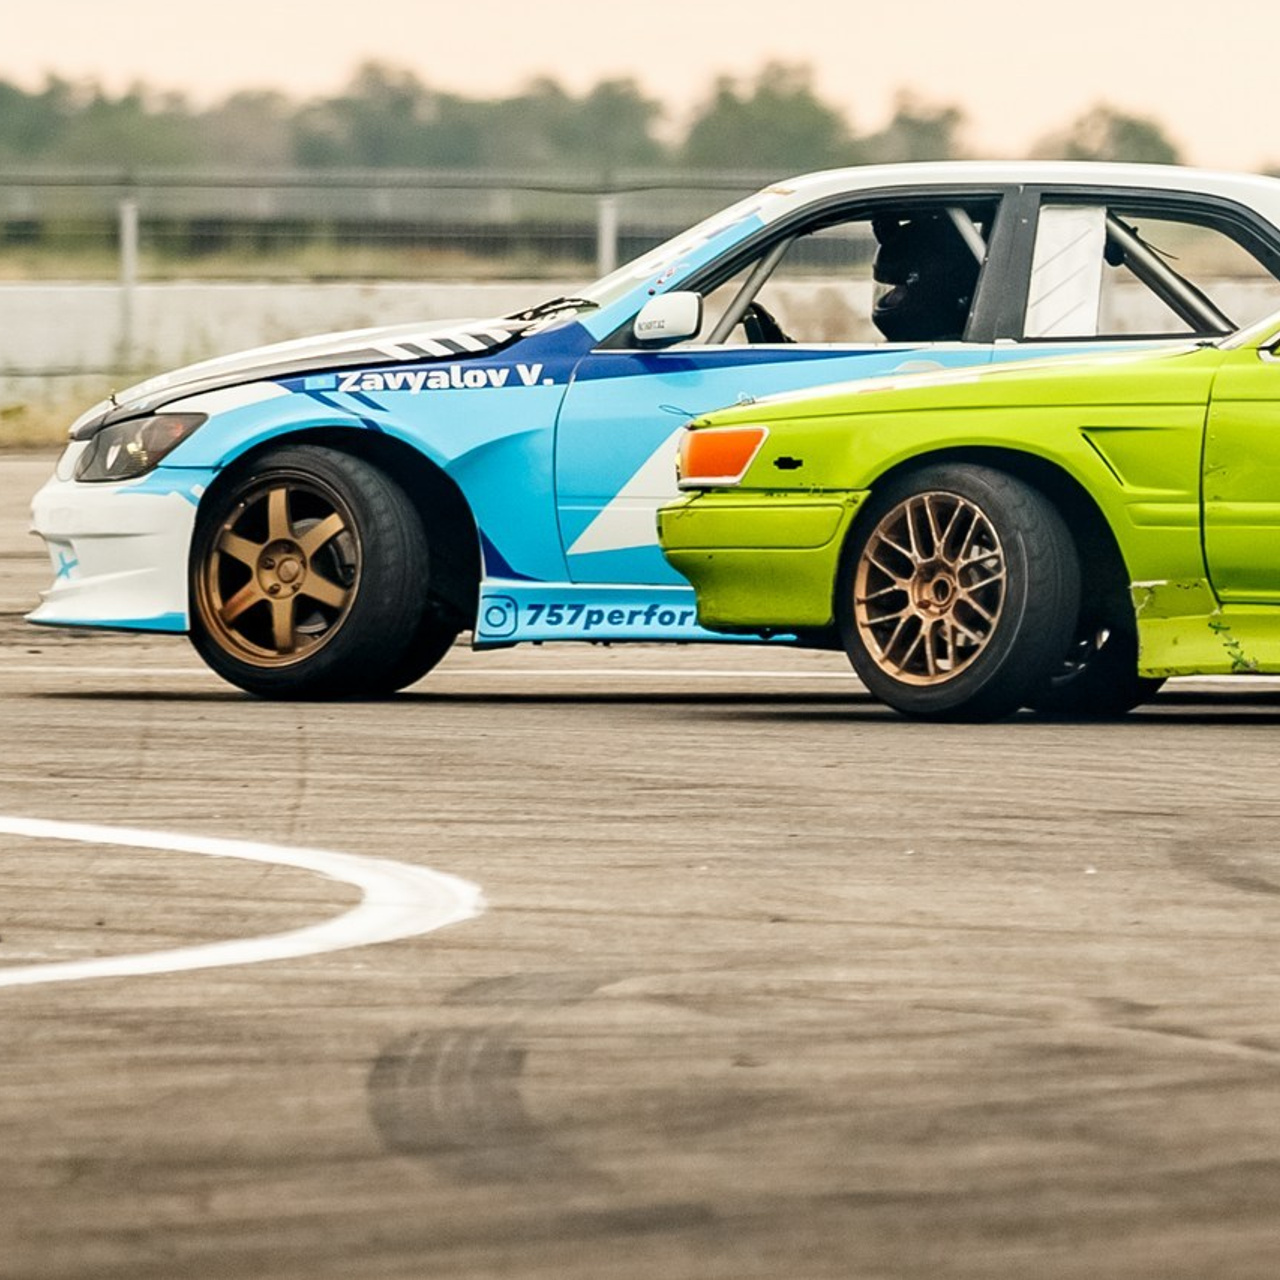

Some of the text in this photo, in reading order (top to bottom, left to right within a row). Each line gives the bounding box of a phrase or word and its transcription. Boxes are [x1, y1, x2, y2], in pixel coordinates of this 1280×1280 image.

[338, 363, 554, 394] Zavyalov V.
[526, 603, 700, 630] 757perfor
